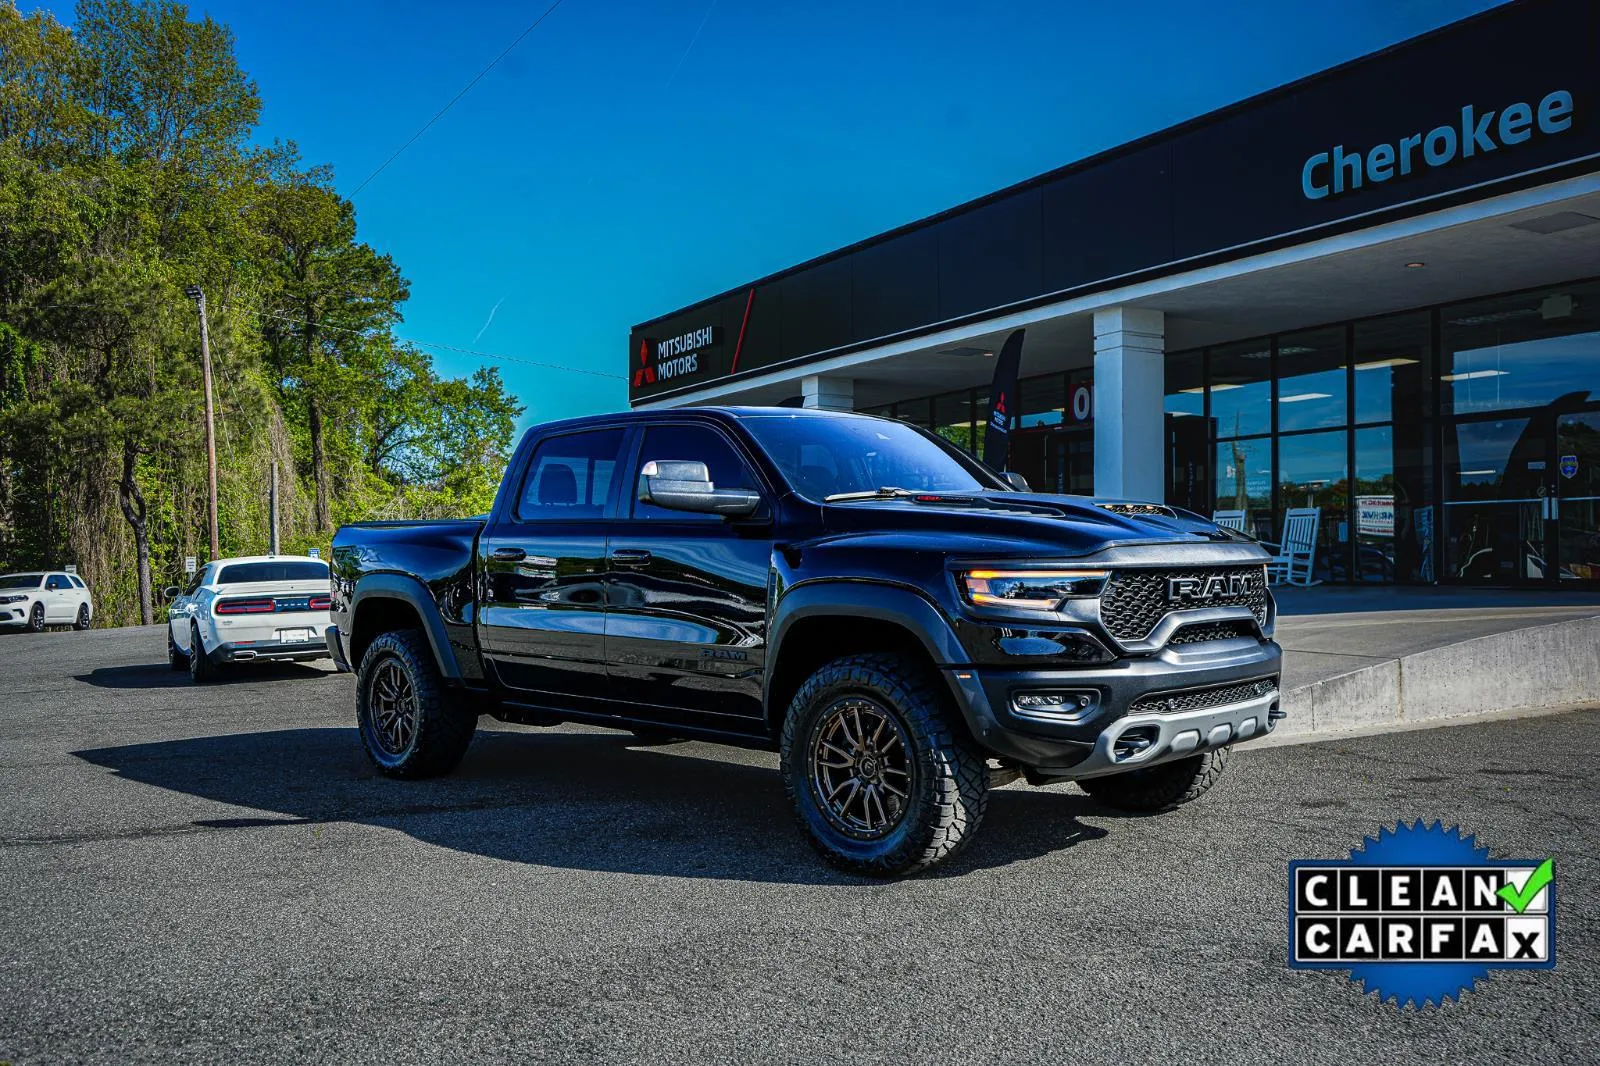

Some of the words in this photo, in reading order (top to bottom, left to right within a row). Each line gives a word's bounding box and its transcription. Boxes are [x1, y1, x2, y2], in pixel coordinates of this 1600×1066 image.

[1302, 90, 1574, 200] Cherokee
[658, 325, 713, 360] MITSUBISHI
[658, 353, 698, 381] MOTORS
[1169, 575, 1252, 600] RAM
